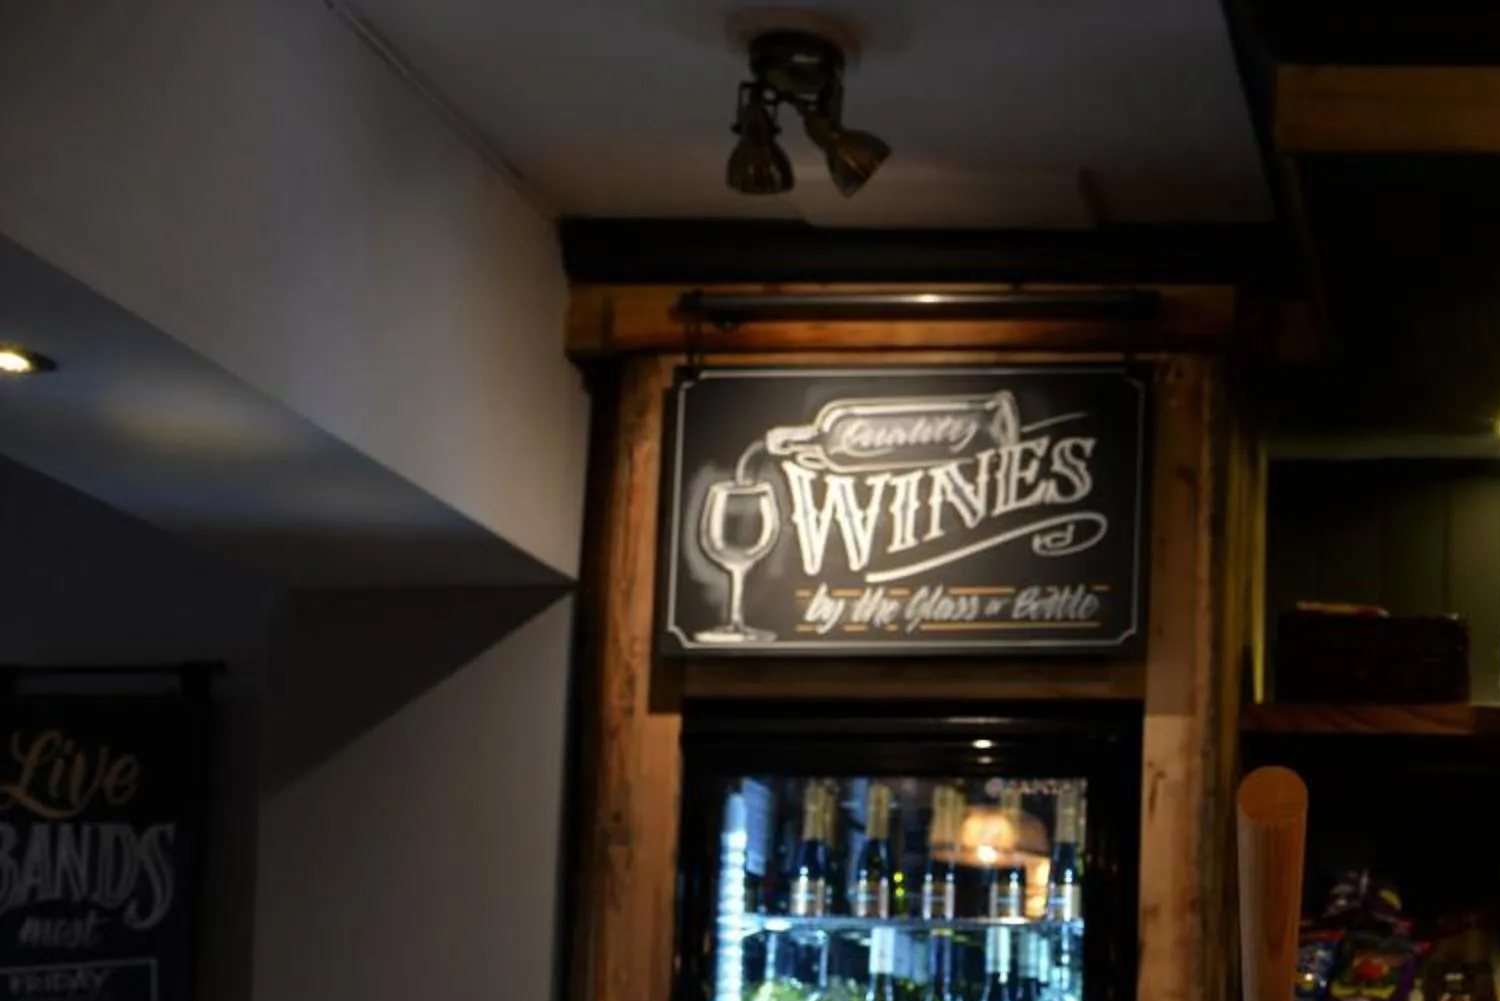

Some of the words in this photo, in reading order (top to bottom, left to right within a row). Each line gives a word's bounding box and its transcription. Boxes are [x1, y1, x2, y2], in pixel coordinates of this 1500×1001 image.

[830, 414, 978, 457] Quality
[781, 437, 1096, 575] WINES
[805, 583, 845, 634] by
[850, 587, 900, 627] the
[904, 584, 979, 635] Glass
[1012, 584, 1100, 620] Bottle
[0, 728, 141, 819] Live
